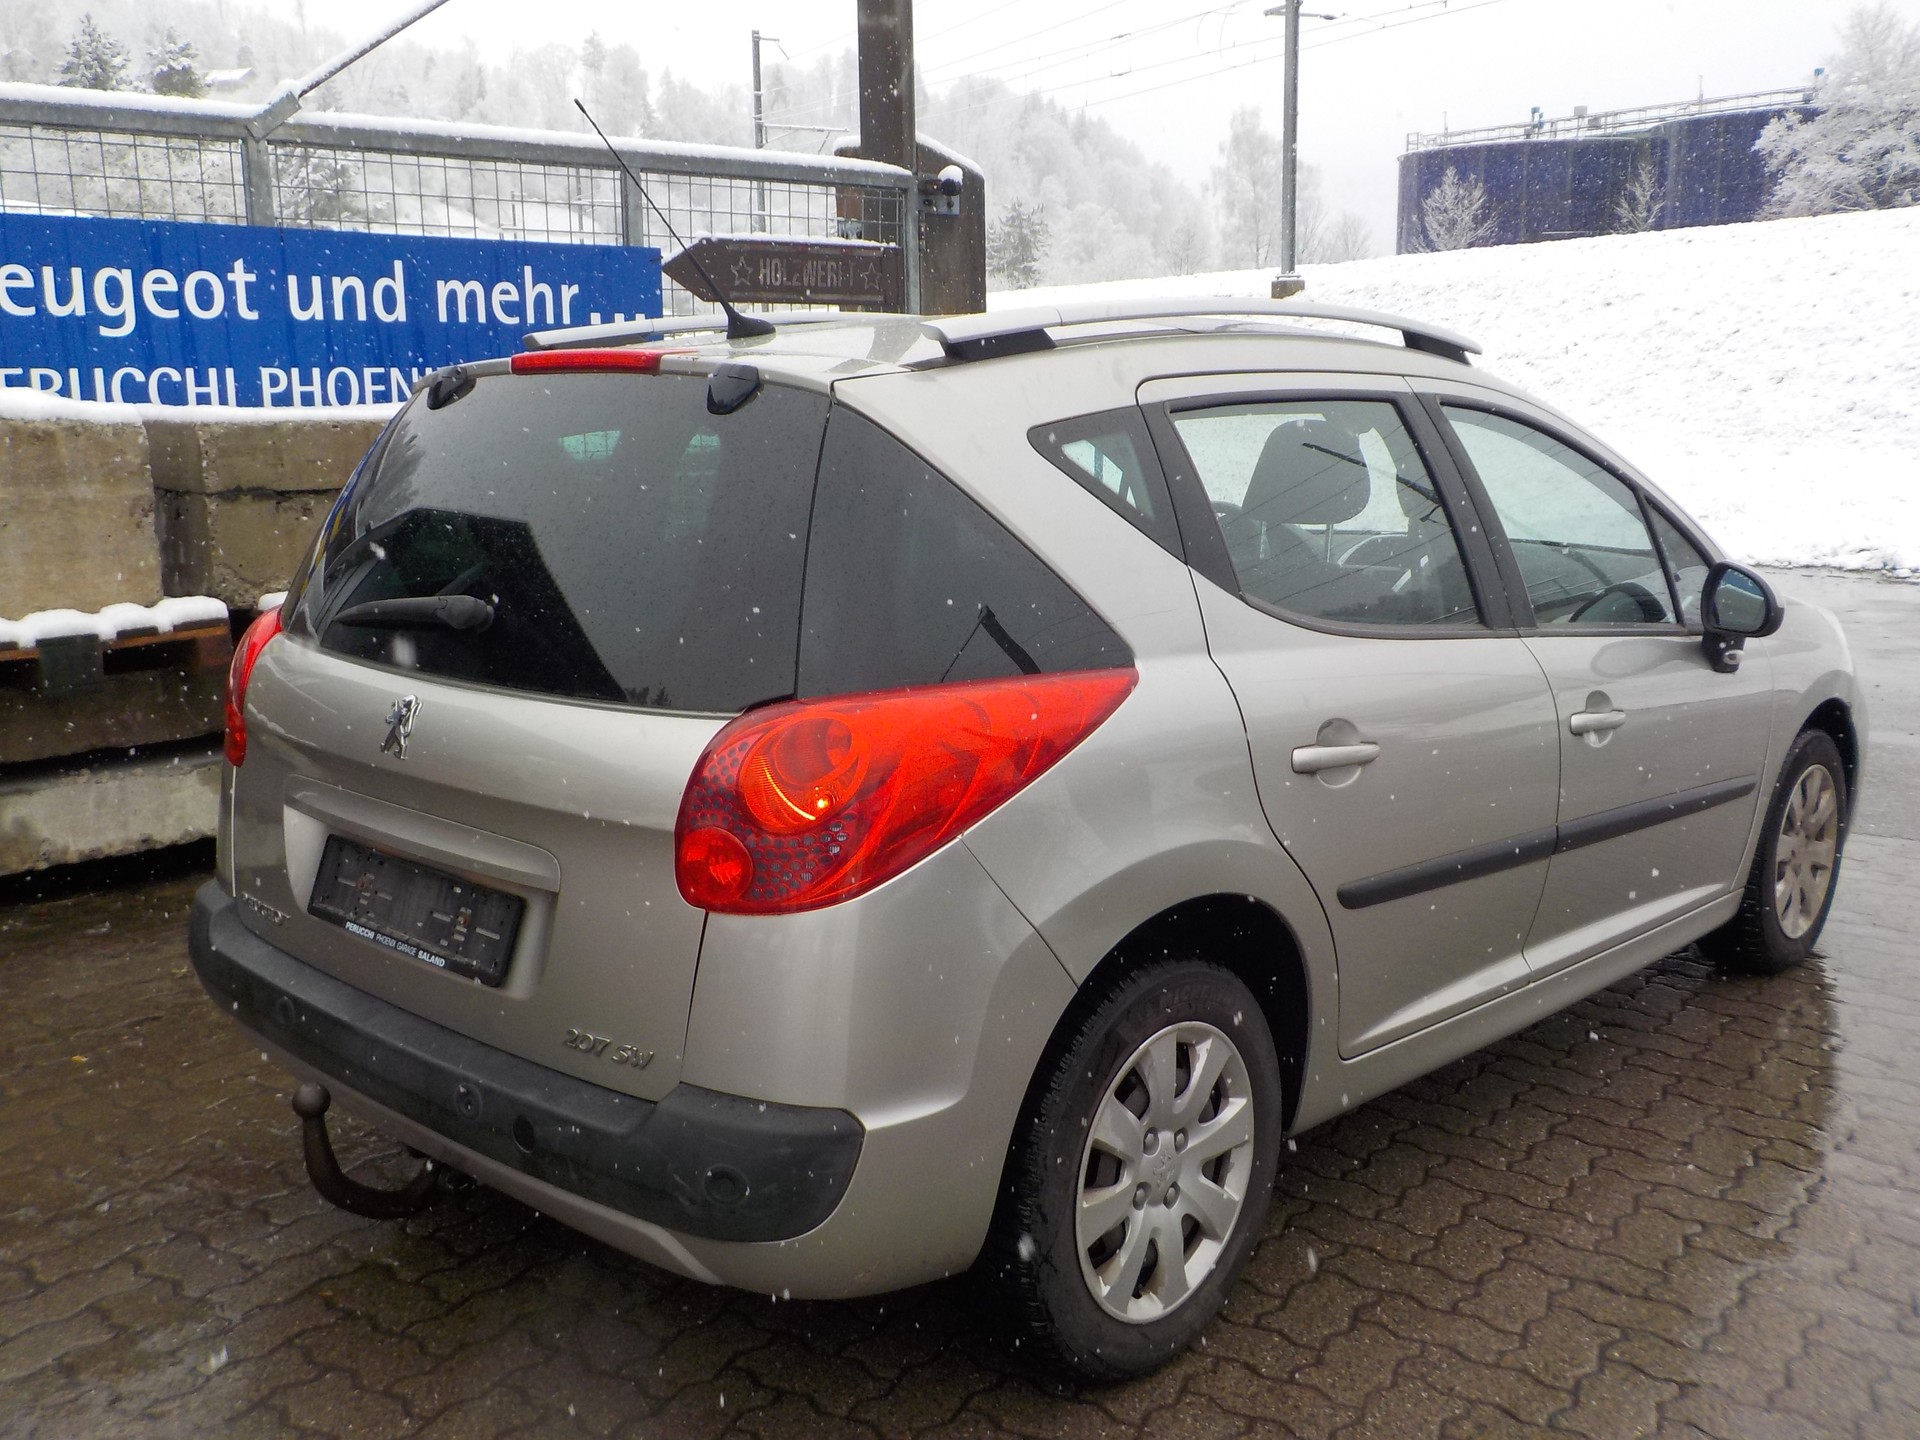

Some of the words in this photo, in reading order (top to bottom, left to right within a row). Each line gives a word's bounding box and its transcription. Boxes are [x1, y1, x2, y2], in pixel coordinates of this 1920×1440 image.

[0, 257, 259, 337] eugeot
[287, 259, 407, 323] und
[260, 366, 441, 408] PHOEN
[345, 921, 375, 940] PERUCCHI
[375, 933, 397, 949] PHOENIX
[396, 941, 417, 957] GARAGE
[417, 949, 446, 967] SALAND
[564, 1028, 611, 1057] 207
[611, 1044, 655, 1070] SW
